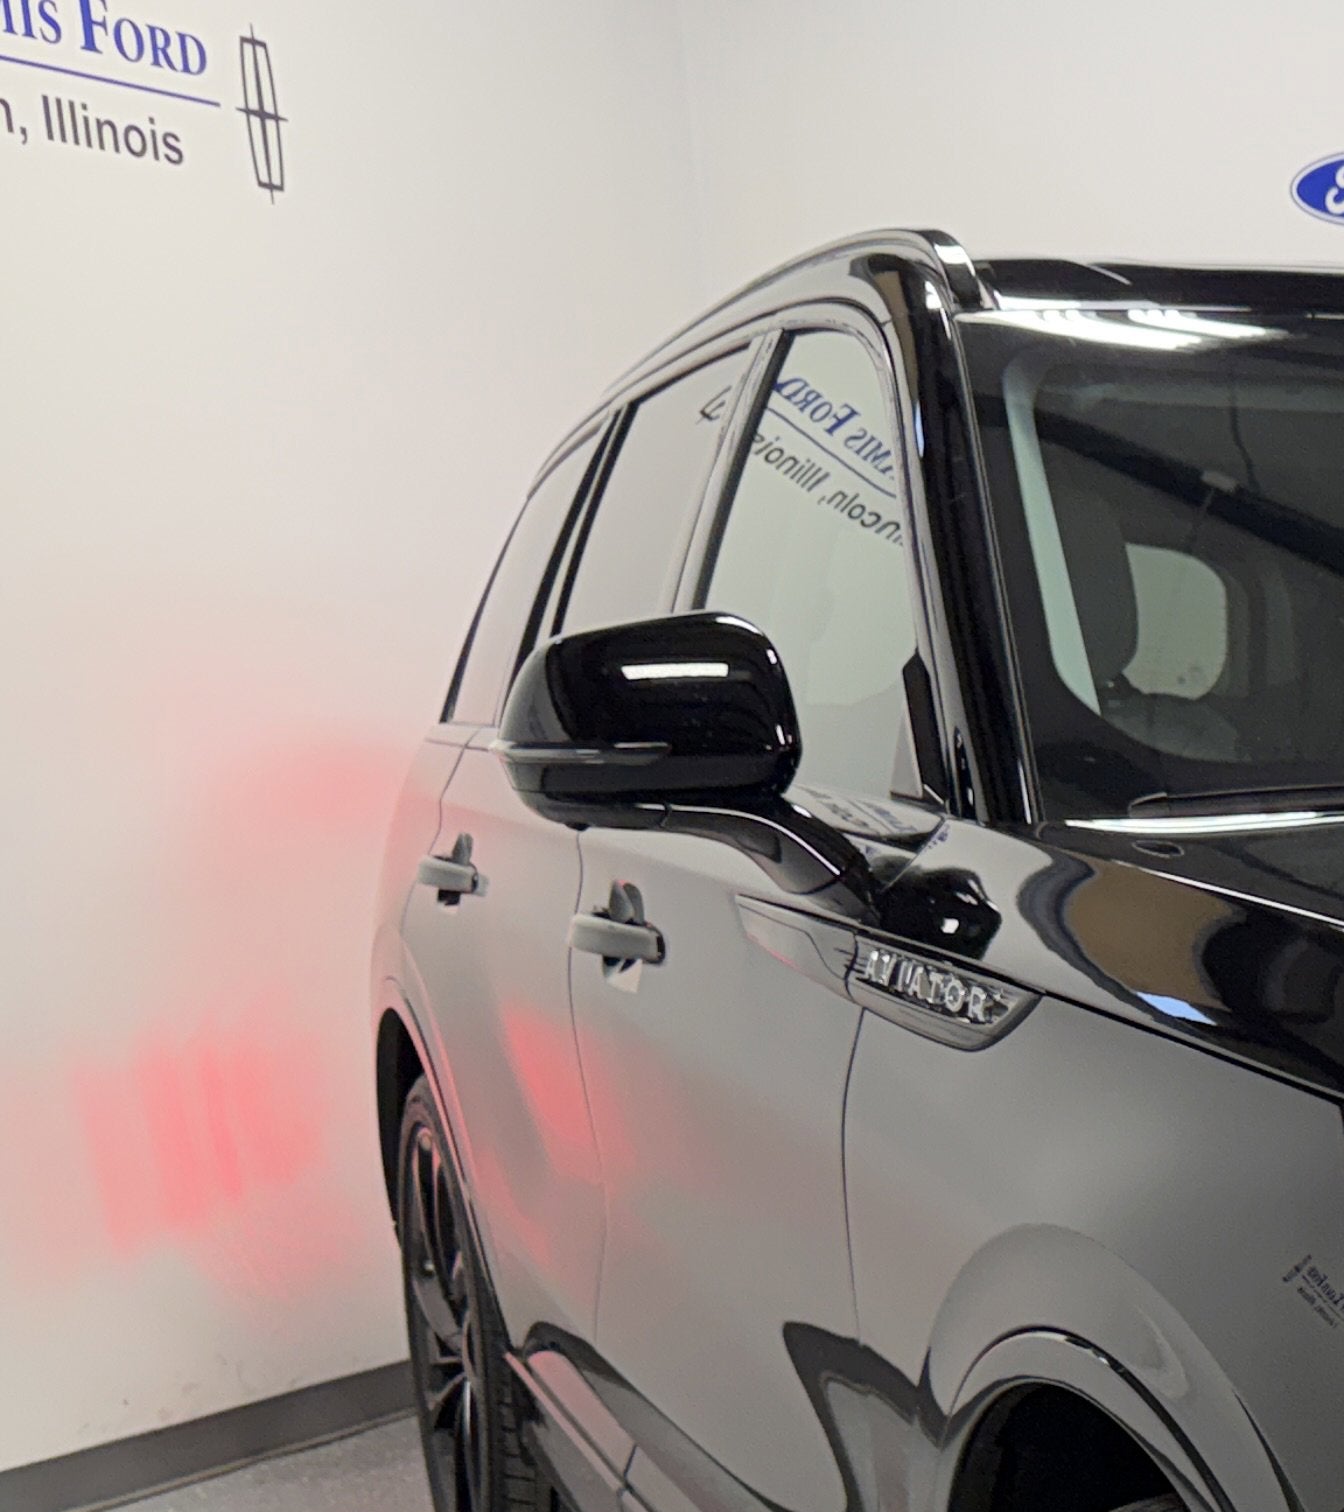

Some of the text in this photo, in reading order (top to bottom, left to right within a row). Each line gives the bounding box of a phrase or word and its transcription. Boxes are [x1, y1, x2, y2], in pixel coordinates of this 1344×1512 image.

[80, 0, 207, 76] FORD
[42, 94, 185, 166] Illinois
[863, 950, 987, 1023] AVIATOR
